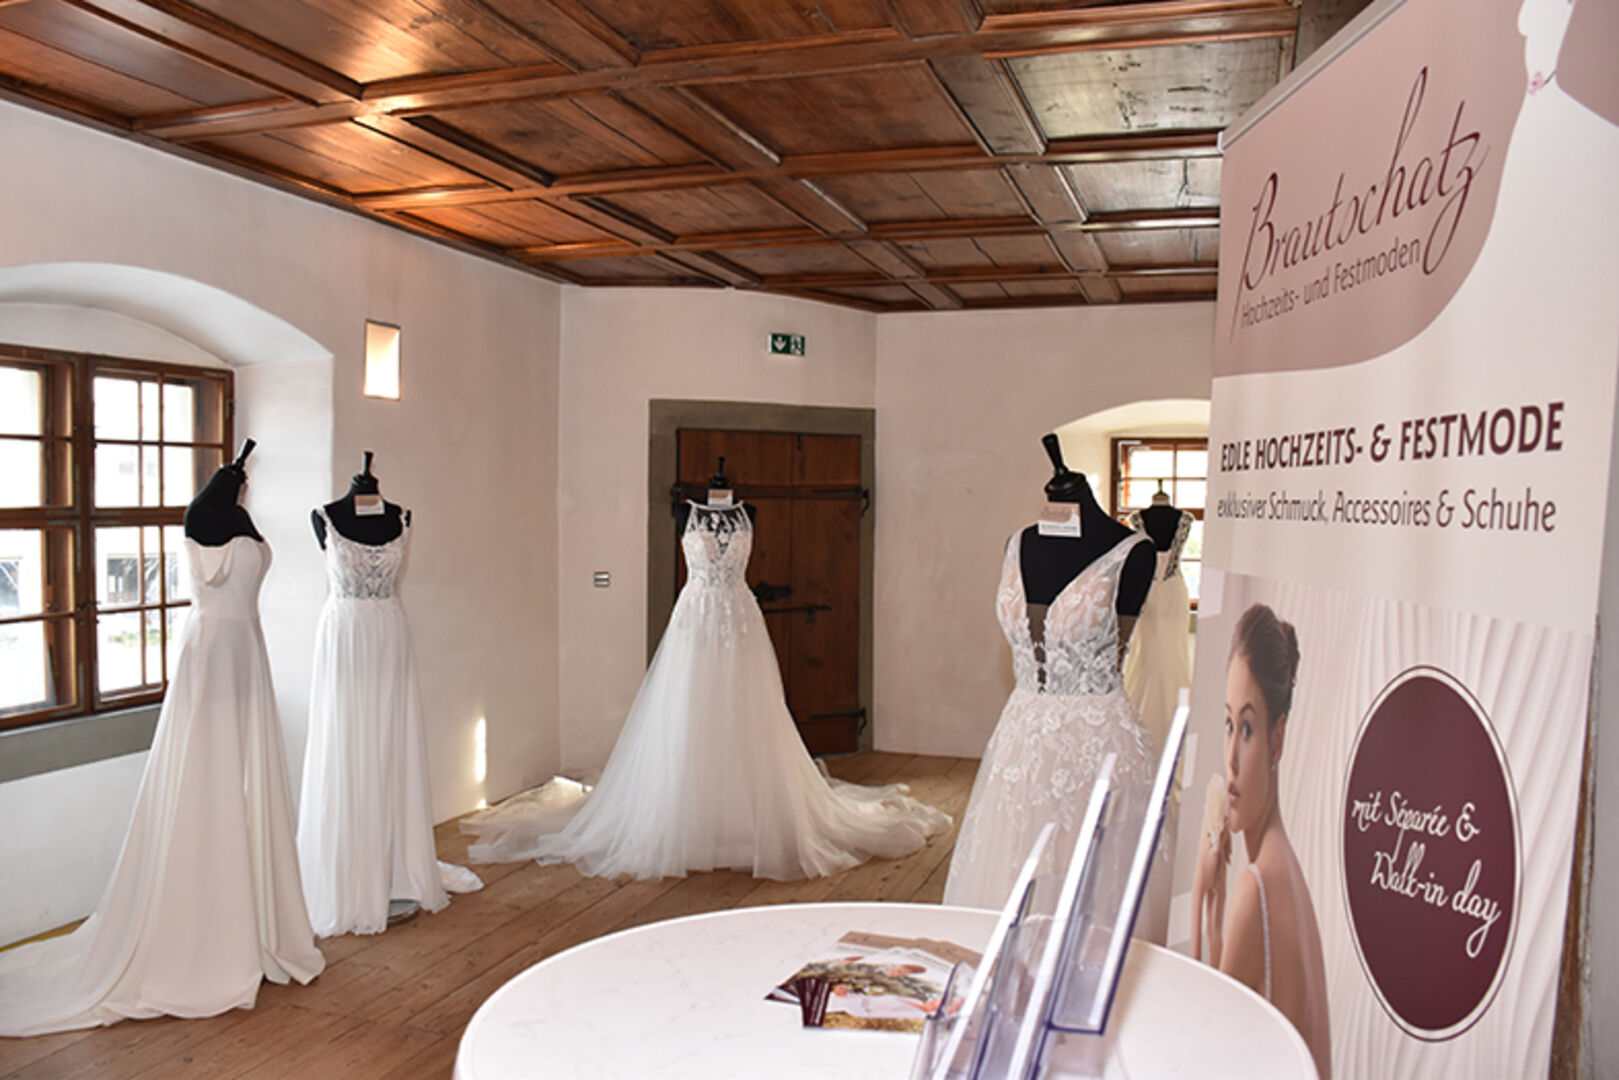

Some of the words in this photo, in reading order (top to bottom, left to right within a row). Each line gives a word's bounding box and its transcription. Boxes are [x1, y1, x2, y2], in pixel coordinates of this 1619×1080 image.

[1230, 66, 1491, 344] Brautschatz
[1241, 287, 1300, 328] Hochzeits-
[1303, 272, 1331, 305] und
[1333, 237, 1420, 293] Festmoden
[1221, 440, 1251, 472] EDLE
[1254, 427, 1363, 471] HOCHZEITS-
[1370, 424, 1391, 462] &
[1399, 402, 1564, 461] FESTMODE
[1217, 492, 1268, 520] exklusiver
[1268, 491, 1328, 525] Schmuck,
[1332, 491, 1430, 527] Accessoires
[1436, 490, 1455, 527] &
[1461, 487, 1557, 532] Schuhe
[1351, 791, 1382, 832] mit
[1456, 802, 1480, 842] &
[1452, 859, 1501, 958] day
